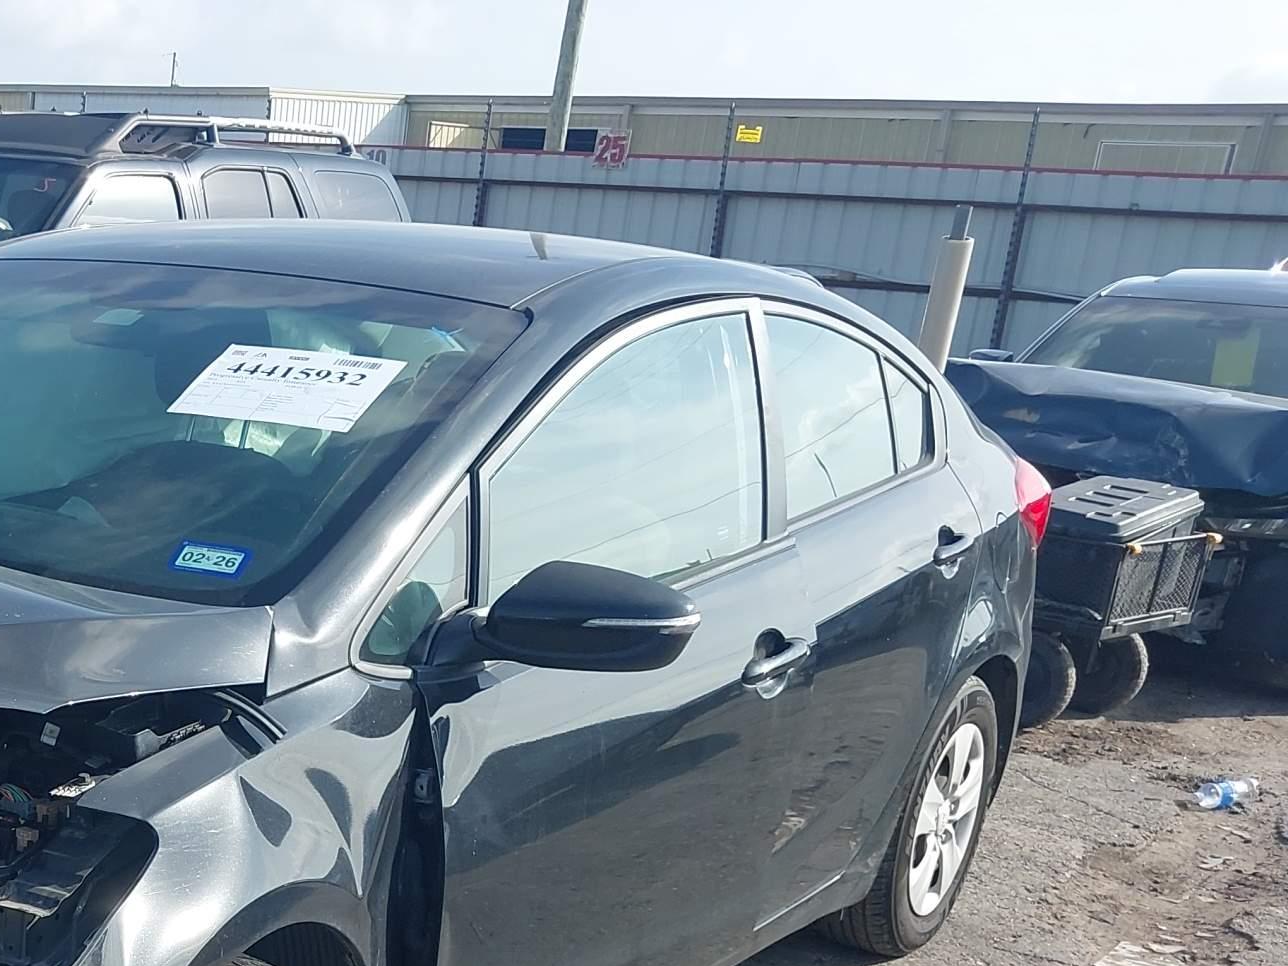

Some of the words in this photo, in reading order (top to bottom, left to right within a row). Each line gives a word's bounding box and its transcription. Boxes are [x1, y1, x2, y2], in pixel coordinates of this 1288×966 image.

[366, 149, 387, 166] 10
[594, 135, 627, 166] 25
[226, 361, 367, 387] 44415932
[182, 551, 206, 563] 02
[213, 556, 238, 568] 26
